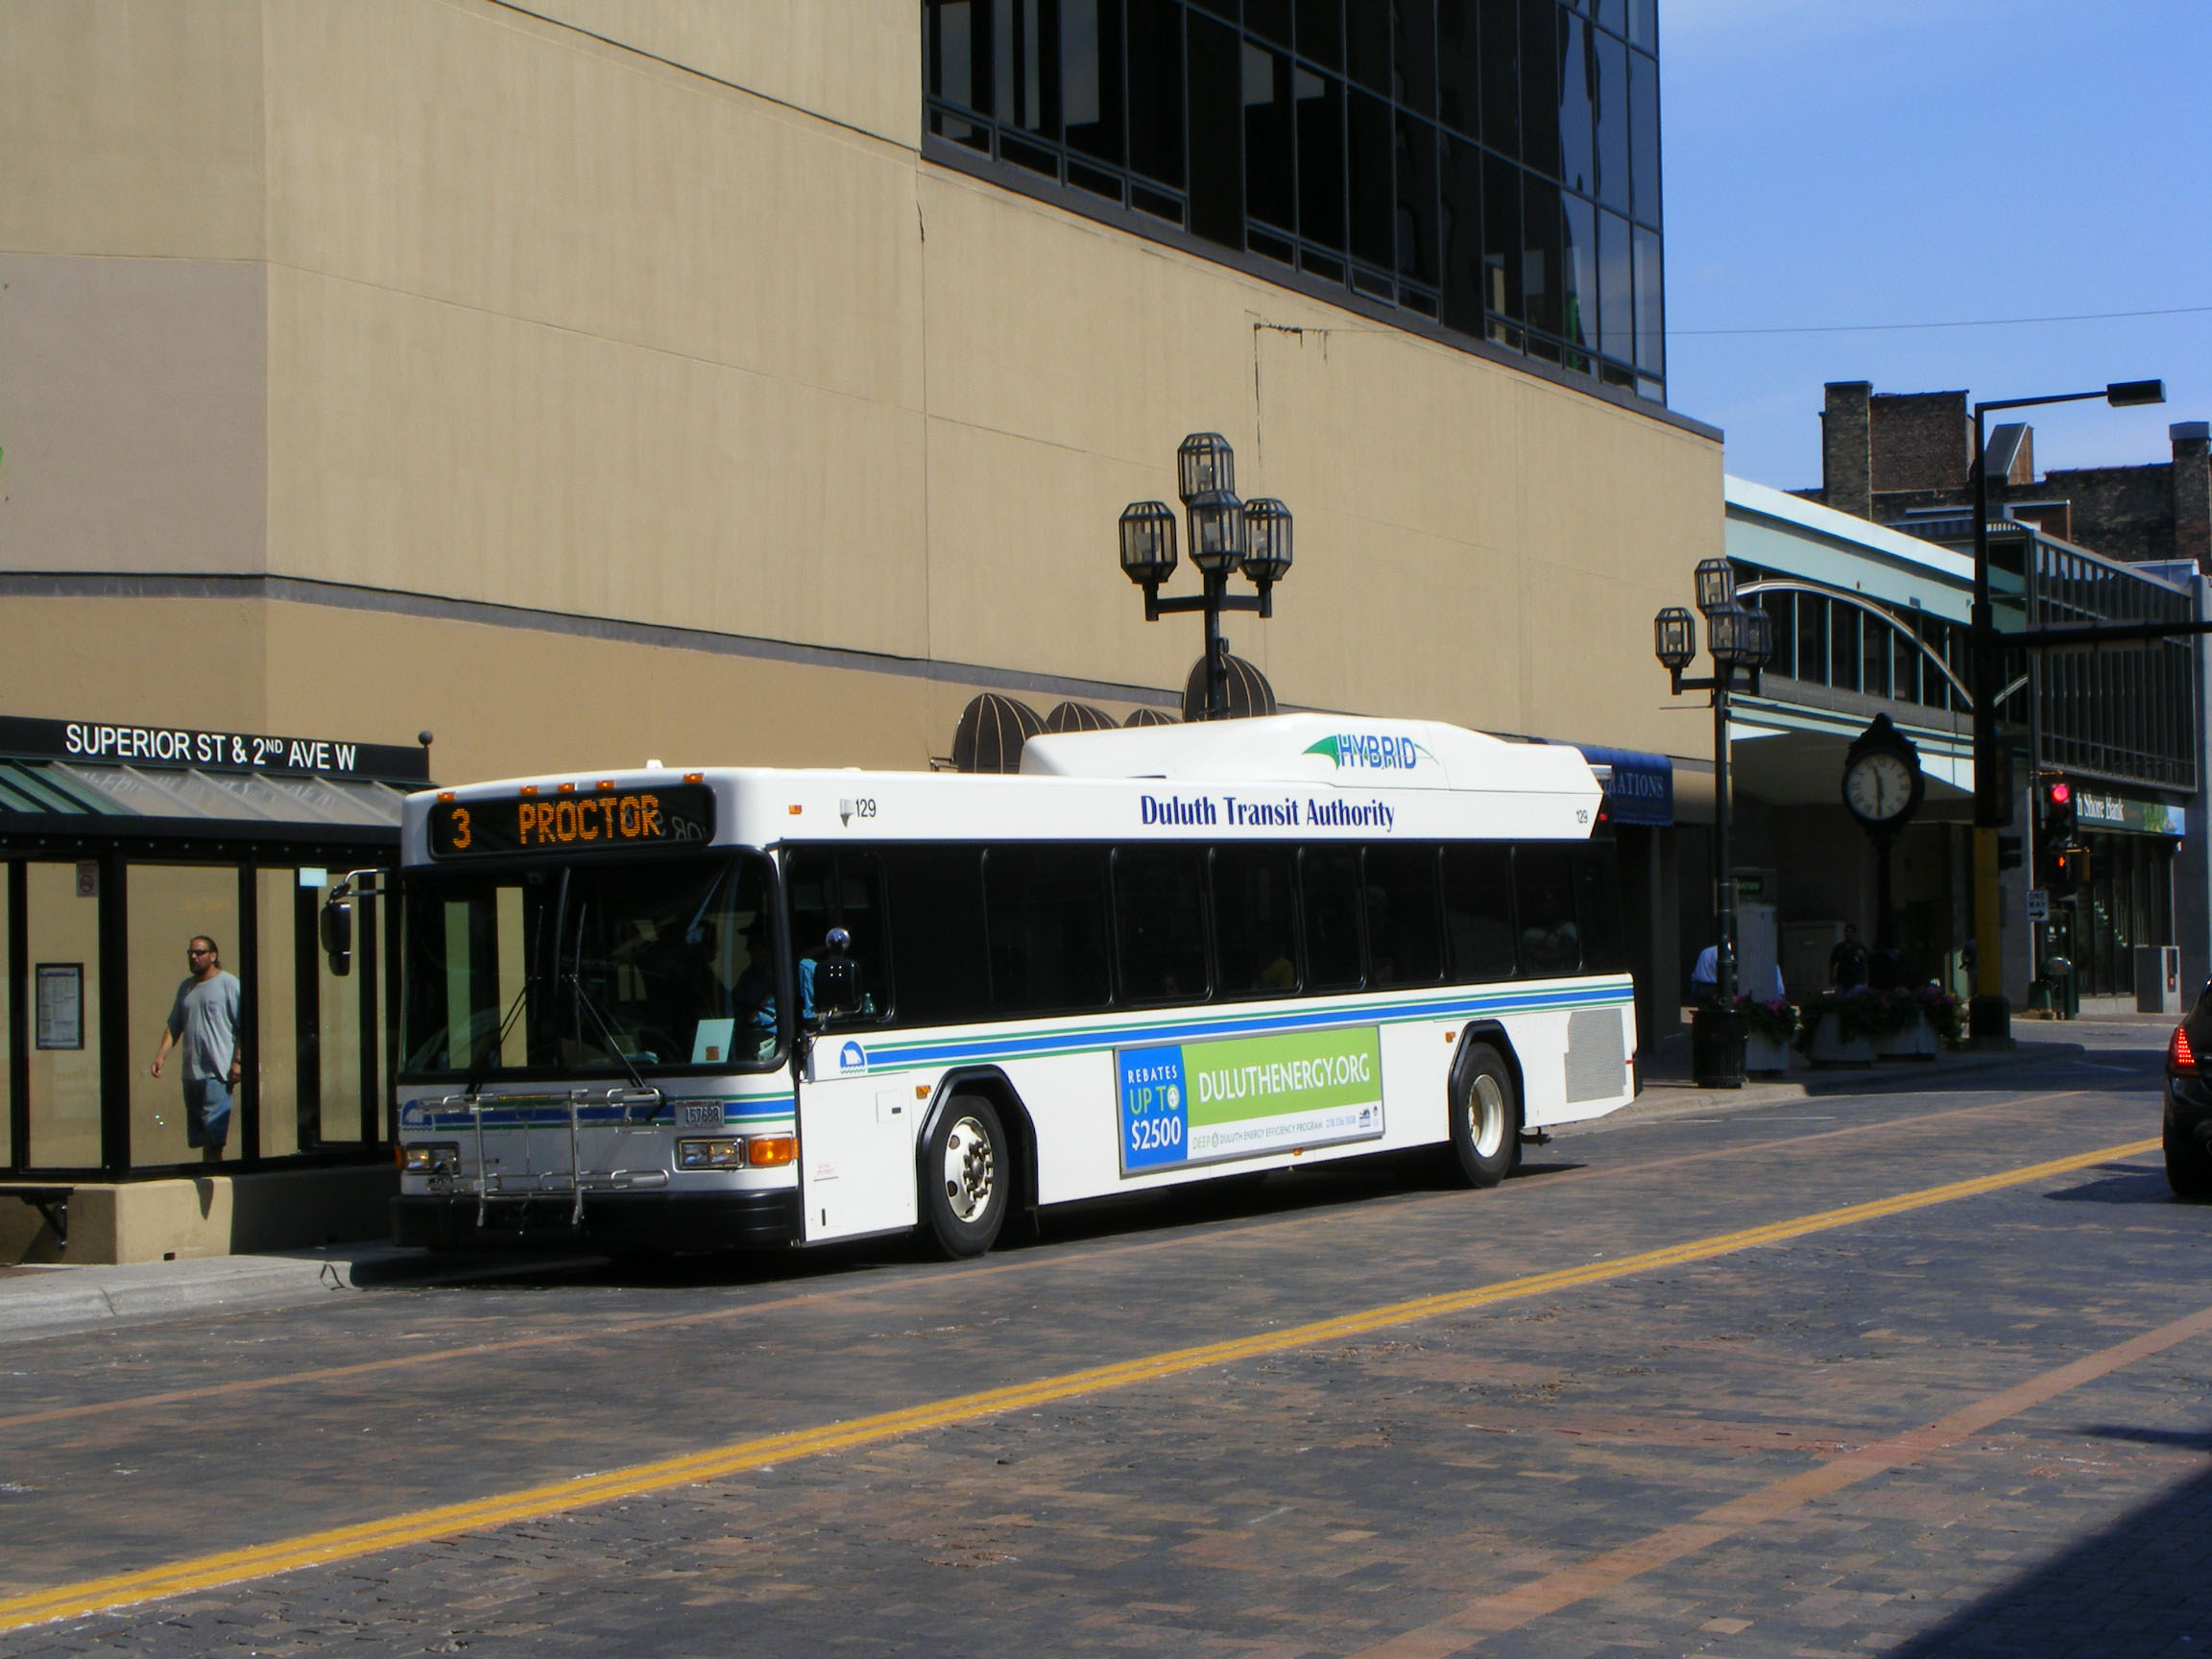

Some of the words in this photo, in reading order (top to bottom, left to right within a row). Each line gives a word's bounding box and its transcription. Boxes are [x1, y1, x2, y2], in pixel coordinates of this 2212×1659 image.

[65, 723, 192, 761] SUPERIOR
[197, 733, 227, 762] ST
[231, 735, 248, 764] &
[252, 737, 284, 765] 2ND
[288, 740, 331, 770] AVE
[335, 743, 356, 771] W
[1337, 733, 1417, 769] HYBRID
[451, 807, 471, 849] 3
[517, 794, 661, 845] PROCTOR
[855, 798, 877, 818] 129
[1141, 795, 1216, 826] Duluth
[1223, 797, 1299, 826] Transit
[1307, 798, 1395, 832] Authority
[1575, 809, 1588, 824] 129
[2083, 793, 2105, 819] Shore
[2105, 796, 2125, 822] Bank
[1127, 1065, 1178, 1084] REBATES
[1198, 1052, 1371, 1103] DULUTHENERGY.ORG
[1129, 1087, 1152, 1116] UP
[1155, 1084, 1180, 1112] TO
[1131, 1116, 1182, 1151] $2500
[1220, 1132, 1243, 1144] DULUTH
[1243, 1129, 1265, 1141] ENERGY
[1265, 1124, 1296, 1138] EFFICIENCY
[1296, 1120, 1323, 1133] PROGRAM
